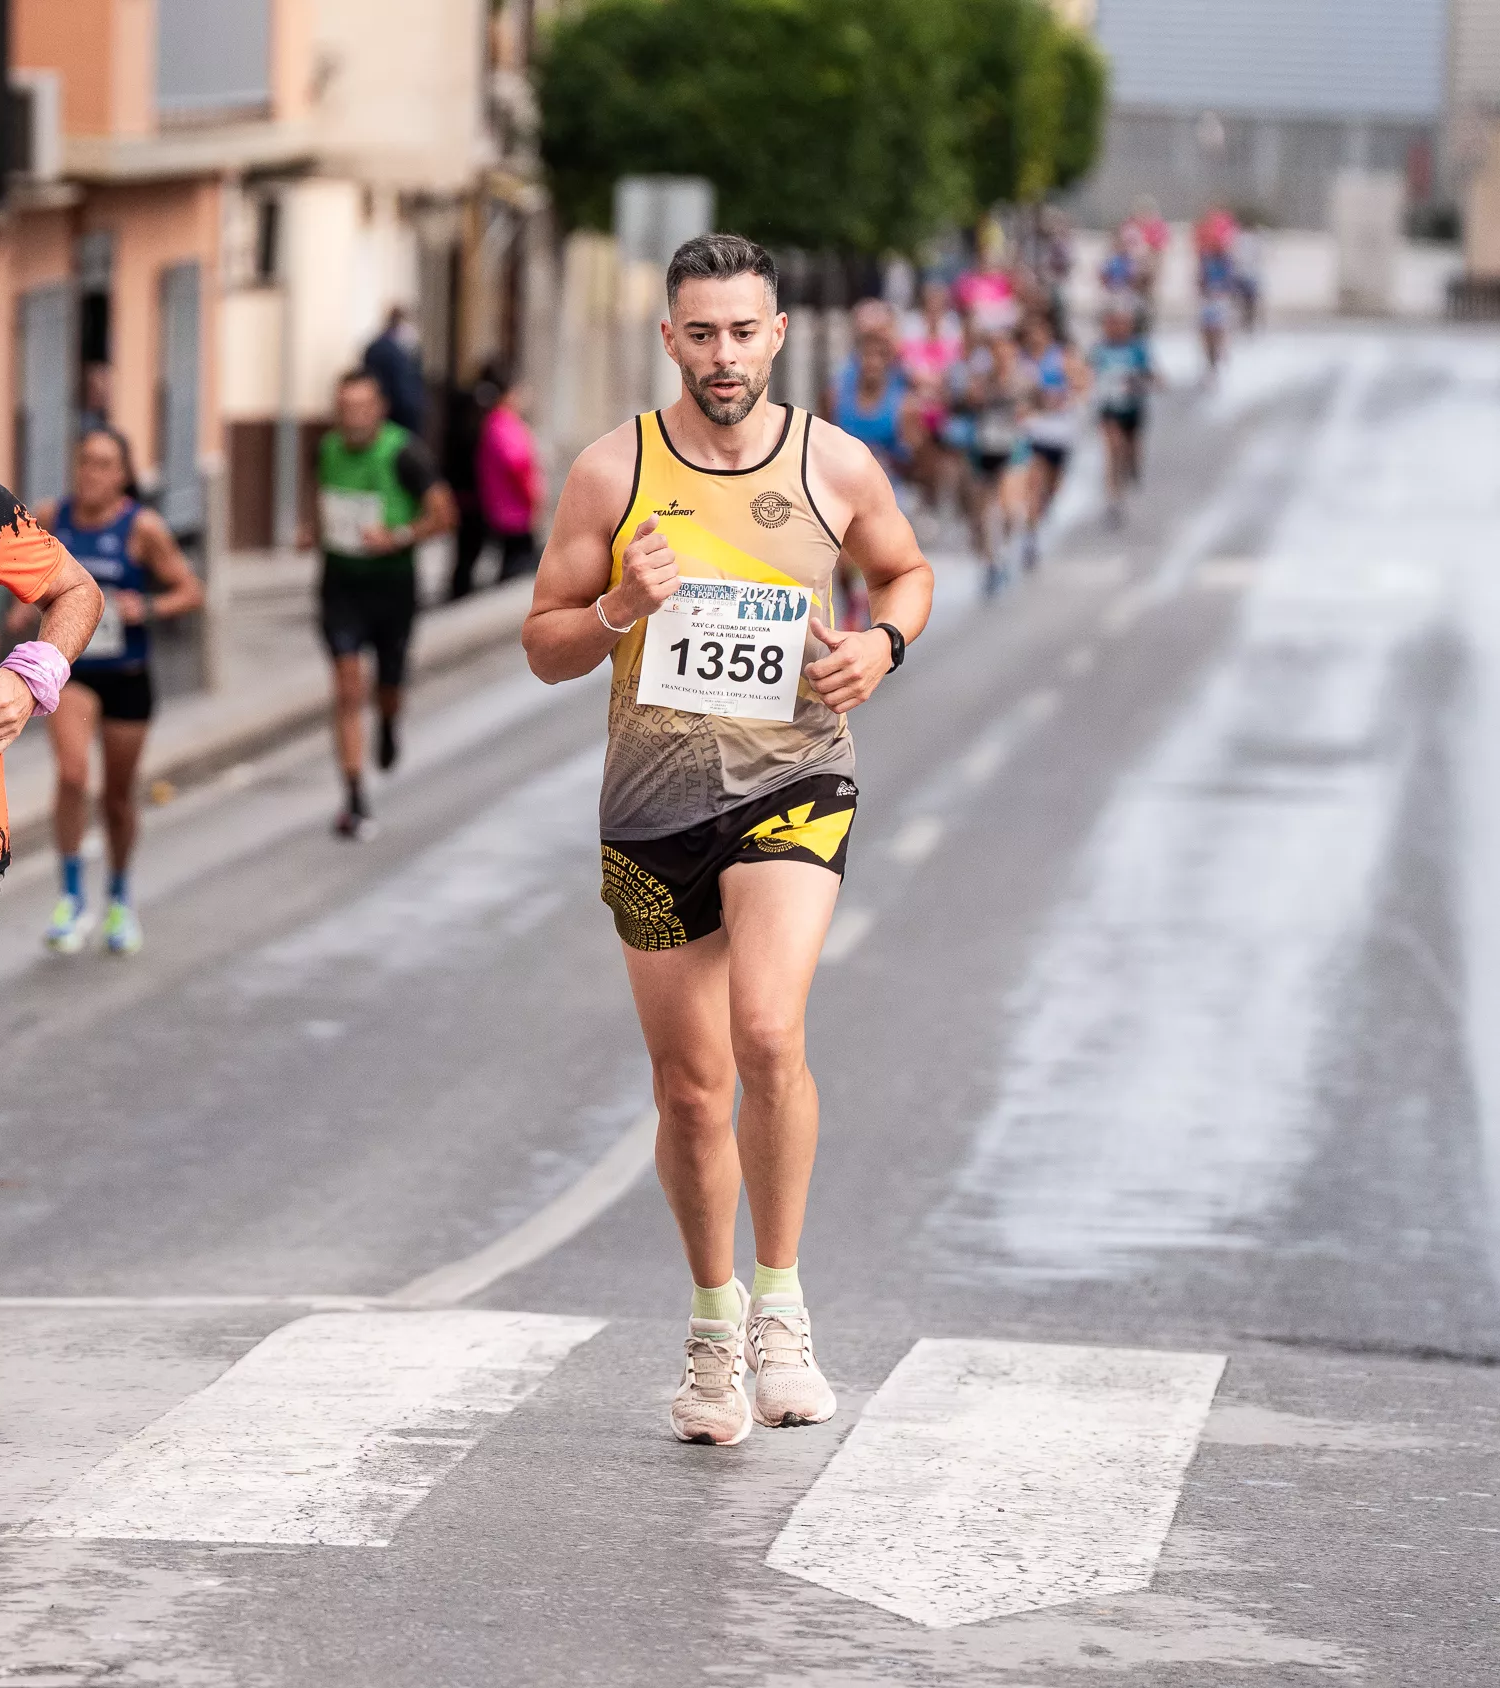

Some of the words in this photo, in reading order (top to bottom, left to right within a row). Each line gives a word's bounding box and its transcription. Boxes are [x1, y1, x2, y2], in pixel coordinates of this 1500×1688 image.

[690, 583, 729, 593] PROVINCIAL
[697, 591, 738, 601] POPULARES
[738, 586, 779, 602] 2024
[716, 623, 739, 631] CIUDAD
[748, 625, 771, 633] LUCENA
[725, 632, 756, 640] IGUALDAD
[670, 637, 784, 685] 1358
[661, 683, 698, 694] FRANCISCO
[699, 689, 725, 697] MANUEL
